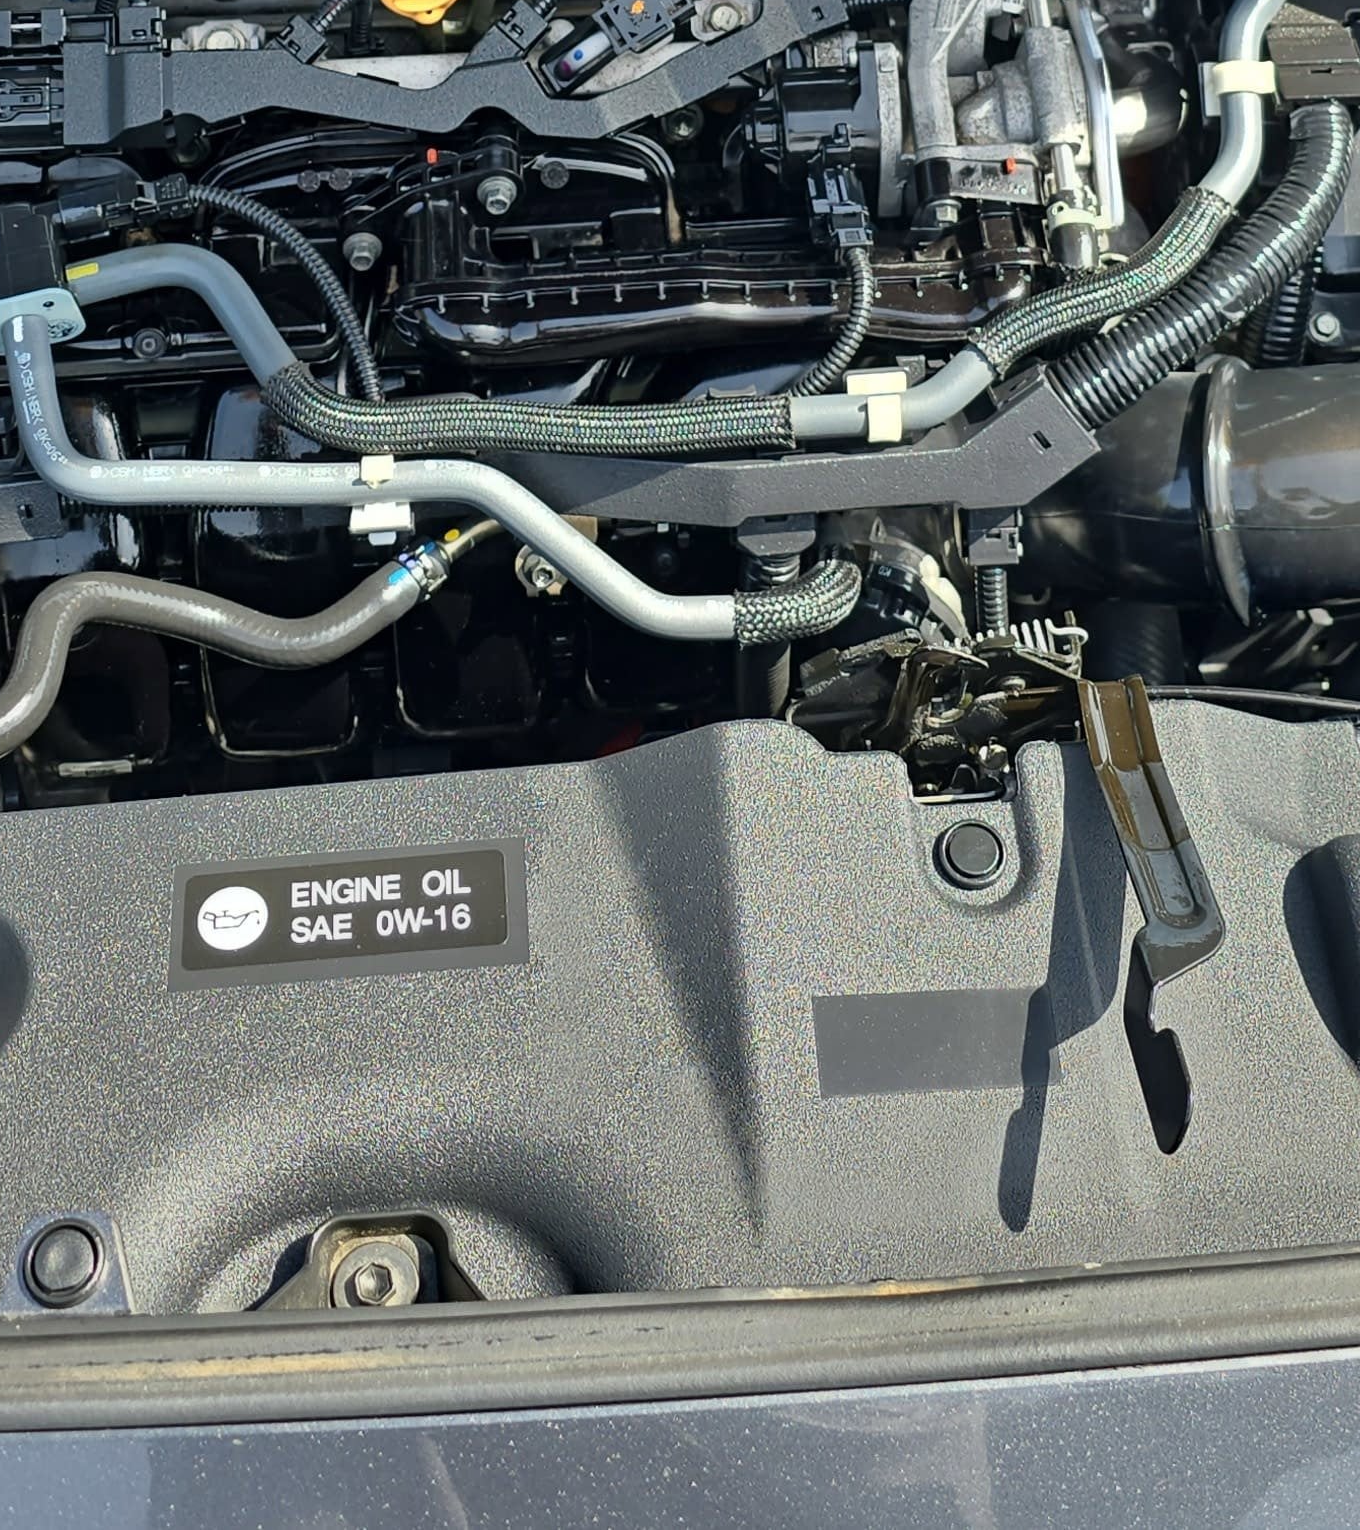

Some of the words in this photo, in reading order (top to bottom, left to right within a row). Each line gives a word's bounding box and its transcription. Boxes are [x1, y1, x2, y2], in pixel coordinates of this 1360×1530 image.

[291, 873, 402, 908] ENGINE
[421, 869, 471, 899] OIL
[290, 912, 353, 945] SAE
[376, 903, 471, 937] 0W-16
